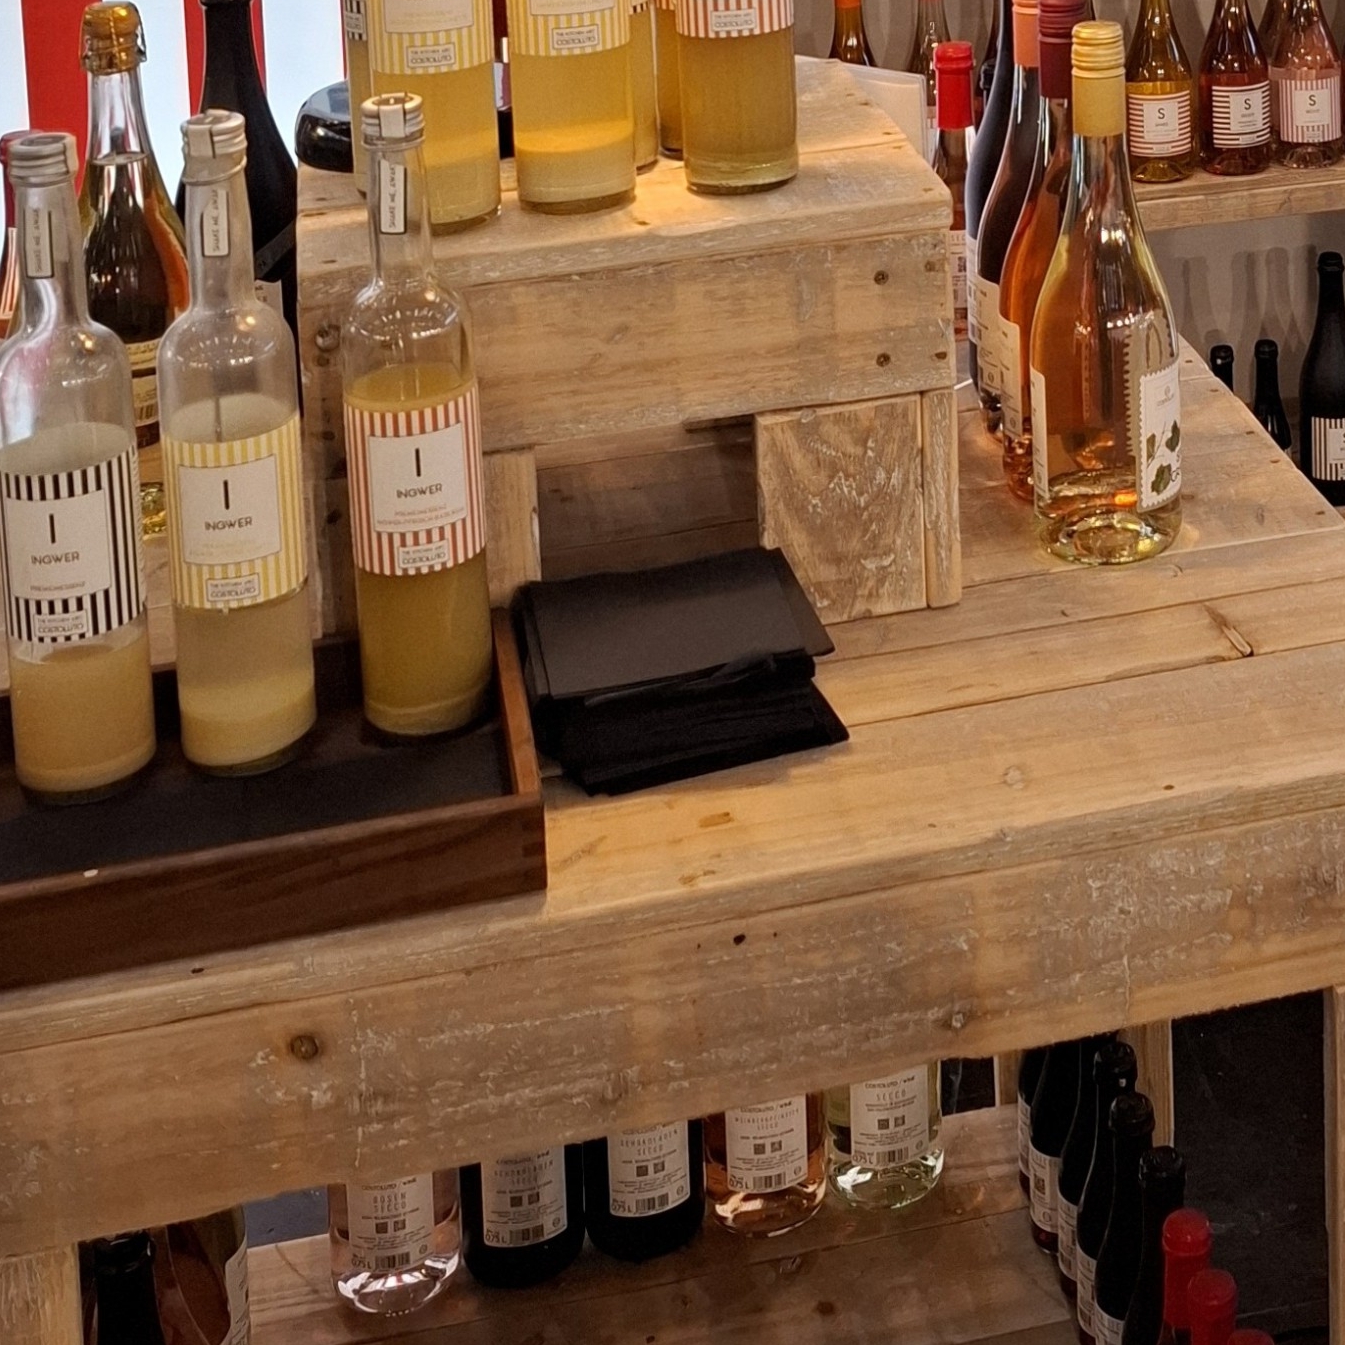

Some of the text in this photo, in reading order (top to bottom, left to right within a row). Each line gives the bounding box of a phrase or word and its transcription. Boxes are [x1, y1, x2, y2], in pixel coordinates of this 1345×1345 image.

[1244, 99, 1251, 110] S
[1309, 95, 1316, 106] S
[1158, 108, 1165, 119] S
[415, 448, 421, 477] I
[223, 480, 229, 510] I
[397, 483, 442, 498] INGWER
[49, 514, 56, 544] I
[205, 517, 253, 531] INGWER
[31, 551, 80, 565] INGWER
